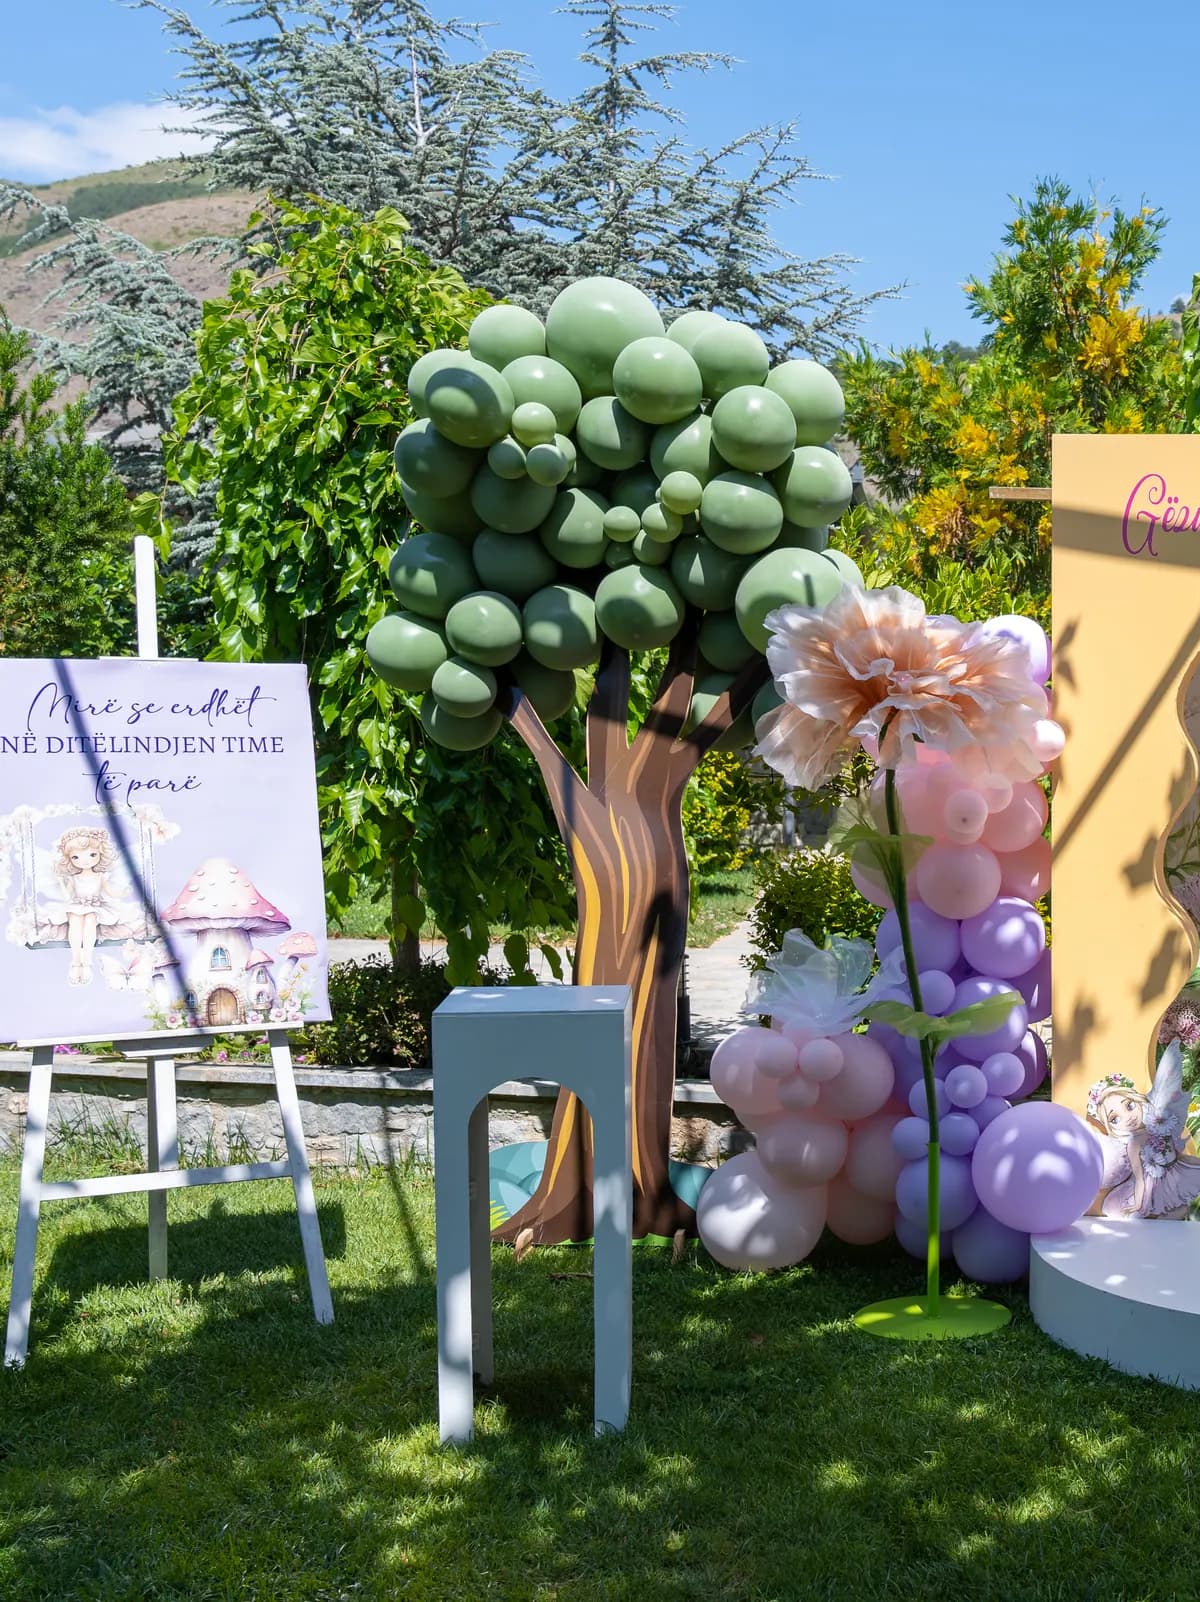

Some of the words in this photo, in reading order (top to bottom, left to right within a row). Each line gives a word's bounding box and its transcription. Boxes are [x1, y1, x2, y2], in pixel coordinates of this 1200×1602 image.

[27, 682, 123, 731] Mirë
[126, 700, 163, 725] se
[170, 685, 278, 727] erdhët
[0, 732, 37, 754] NË
[45, 732, 216, 757] DITËLINDJEN
[221, 736, 286, 754] TIME
[82, 760, 127, 805] të
[126, 775, 203, 808] parë
